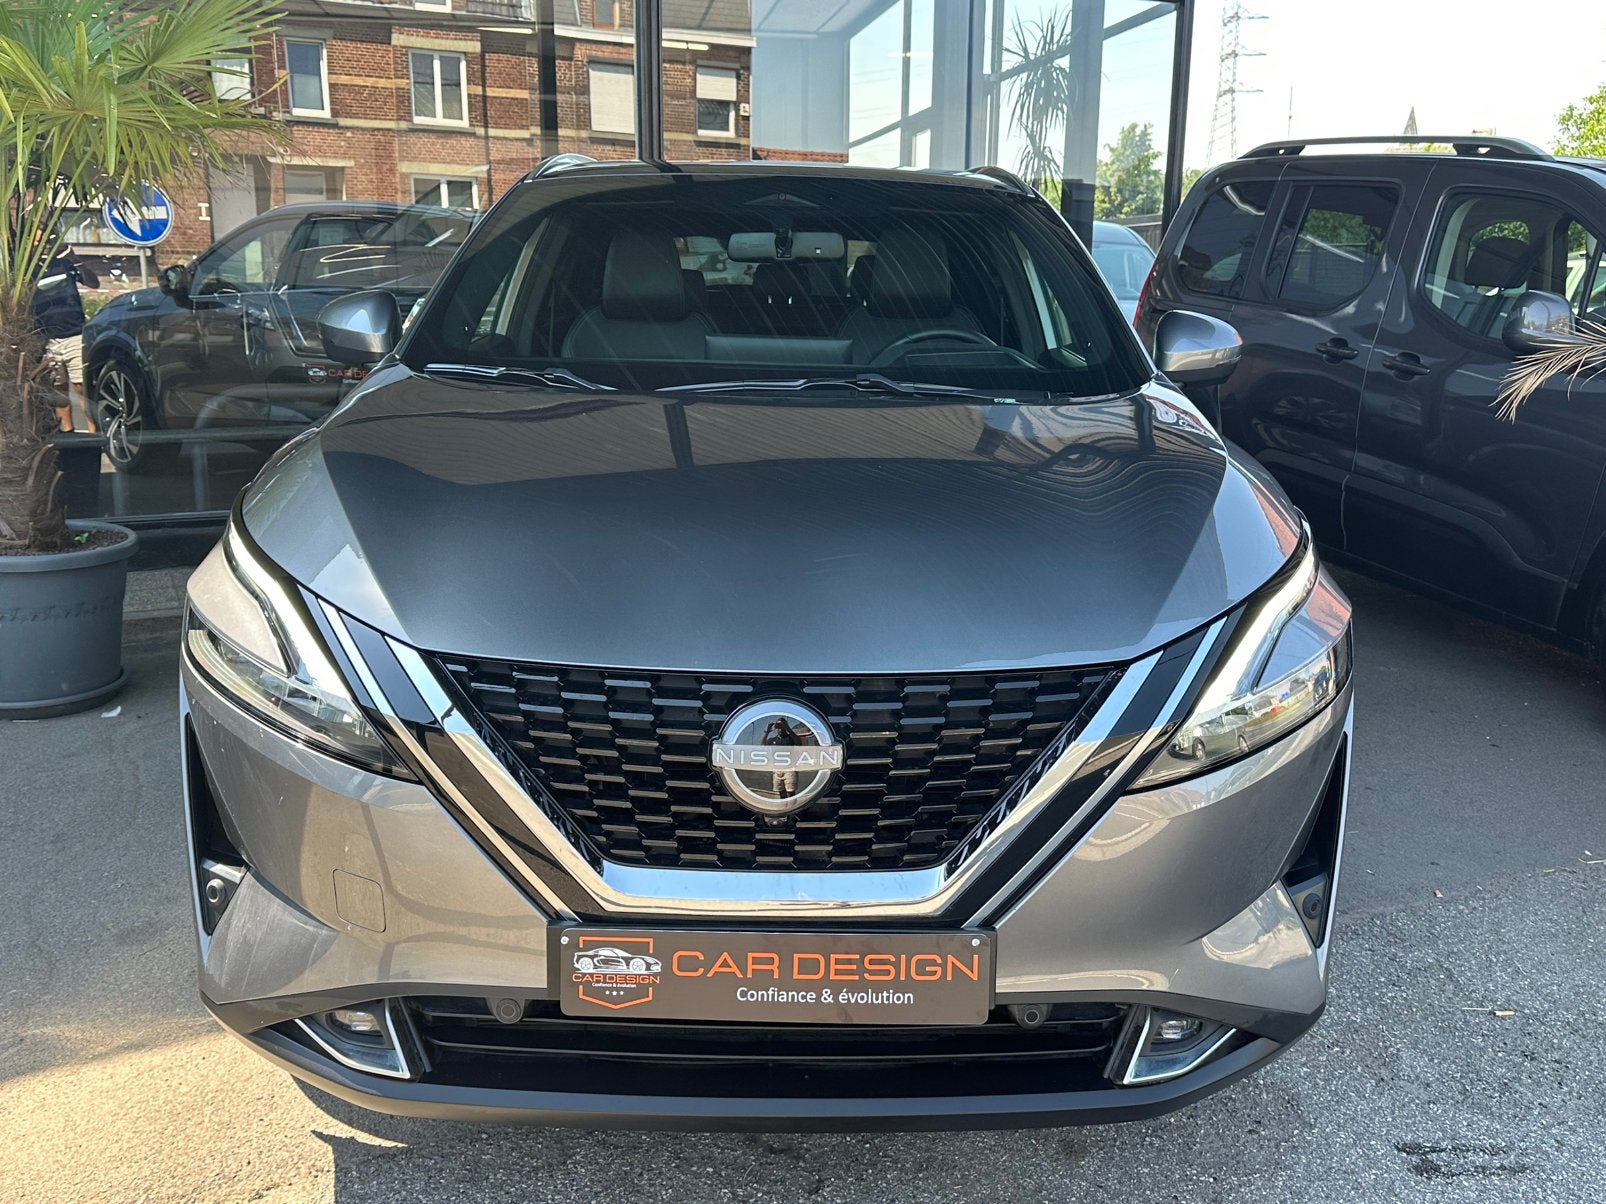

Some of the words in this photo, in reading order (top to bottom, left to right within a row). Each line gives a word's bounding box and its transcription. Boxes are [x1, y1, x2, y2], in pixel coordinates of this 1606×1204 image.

[329, 369, 352, 377] CAR
[716, 748, 838, 767] NISSAN
[672, 950, 780, 979] CAR
[792, 953, 979, 981] DESIGN
[572, 973, 604, 983] CAR
[606, 974, 660, 984] DESIGN
[736, 987, 816, 1003] Confiance
[821, 988, 834, 1004] &
[838, 988, 914, 1005] évolution
